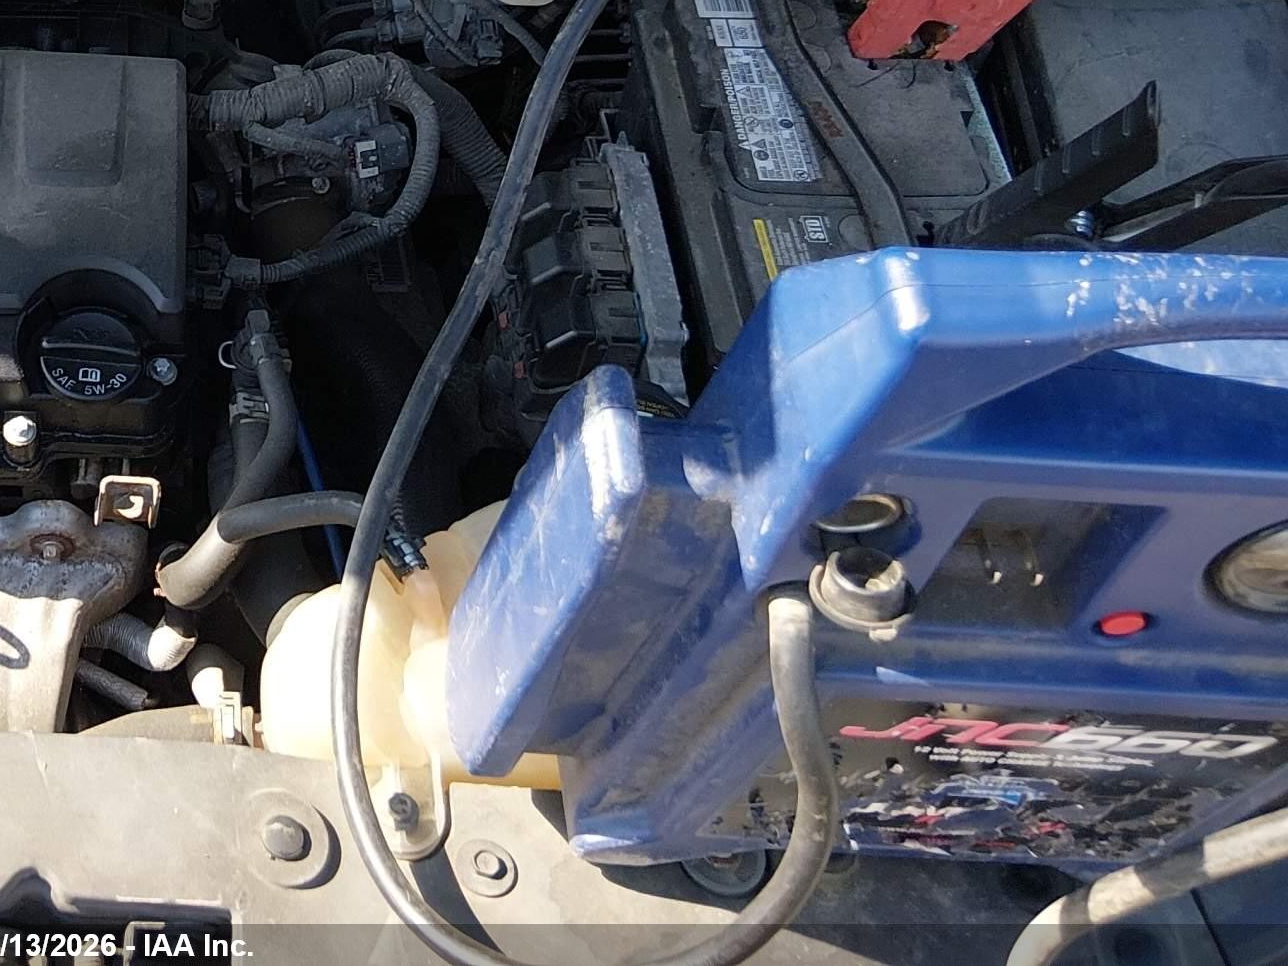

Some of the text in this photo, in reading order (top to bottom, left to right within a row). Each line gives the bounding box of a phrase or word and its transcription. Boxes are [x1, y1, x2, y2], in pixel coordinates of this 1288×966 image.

[720, 68, 748, 141] DANGER/POISON
[804, 219, 826, 240] STD
[84, 373, 127, 395] 5W-30
[839, 716, 1279, 759] JNC660
